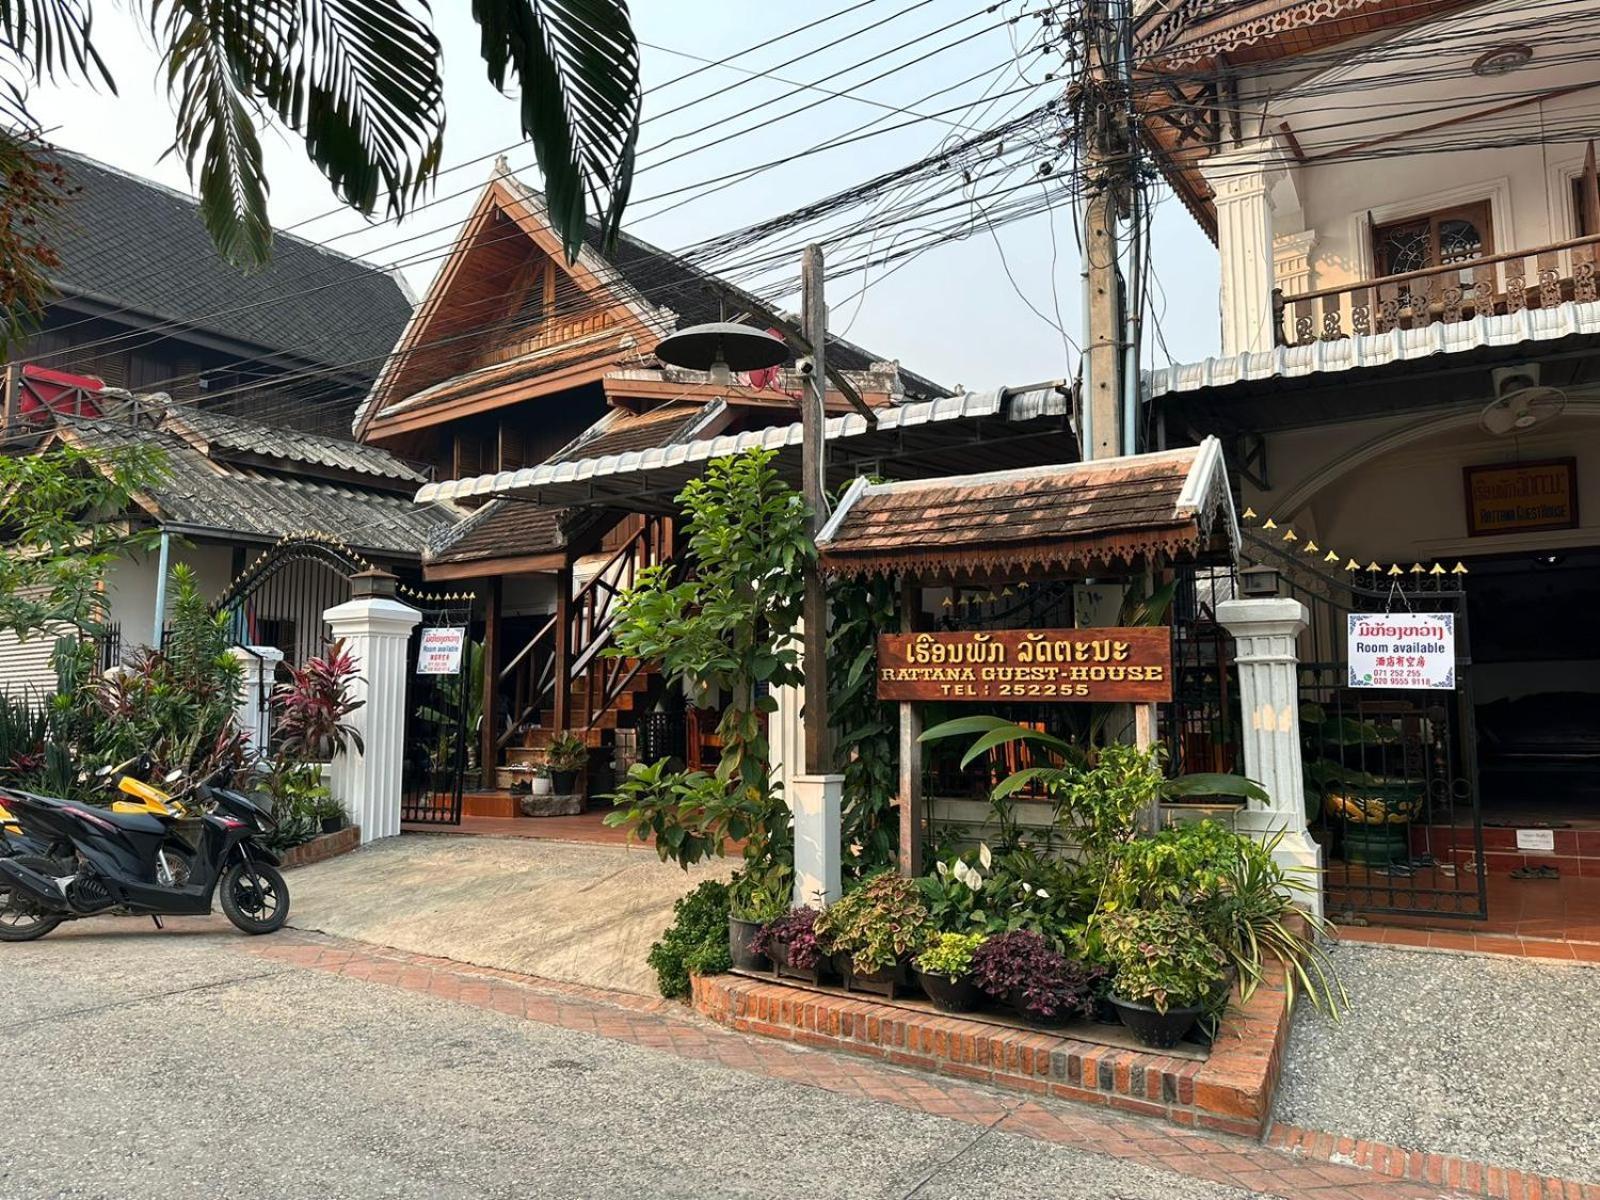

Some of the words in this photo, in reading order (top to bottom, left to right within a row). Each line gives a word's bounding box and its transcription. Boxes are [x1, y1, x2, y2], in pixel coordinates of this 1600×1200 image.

[1356, 642, 1389, 653] Room
[1393, 642, 1445, 654] available
[881, 667, 977, 681] RATTANA
[981, 665, 1164, 682] GUEST-HOUSE
[1373, 669, 1387, 678] 071
[1390, 669, 1404, 677] 252
[1406, 669, 1421, 678] 255
[1373, 677, 1388, 686] 020
[999, 683, 1090, 696] 252255
